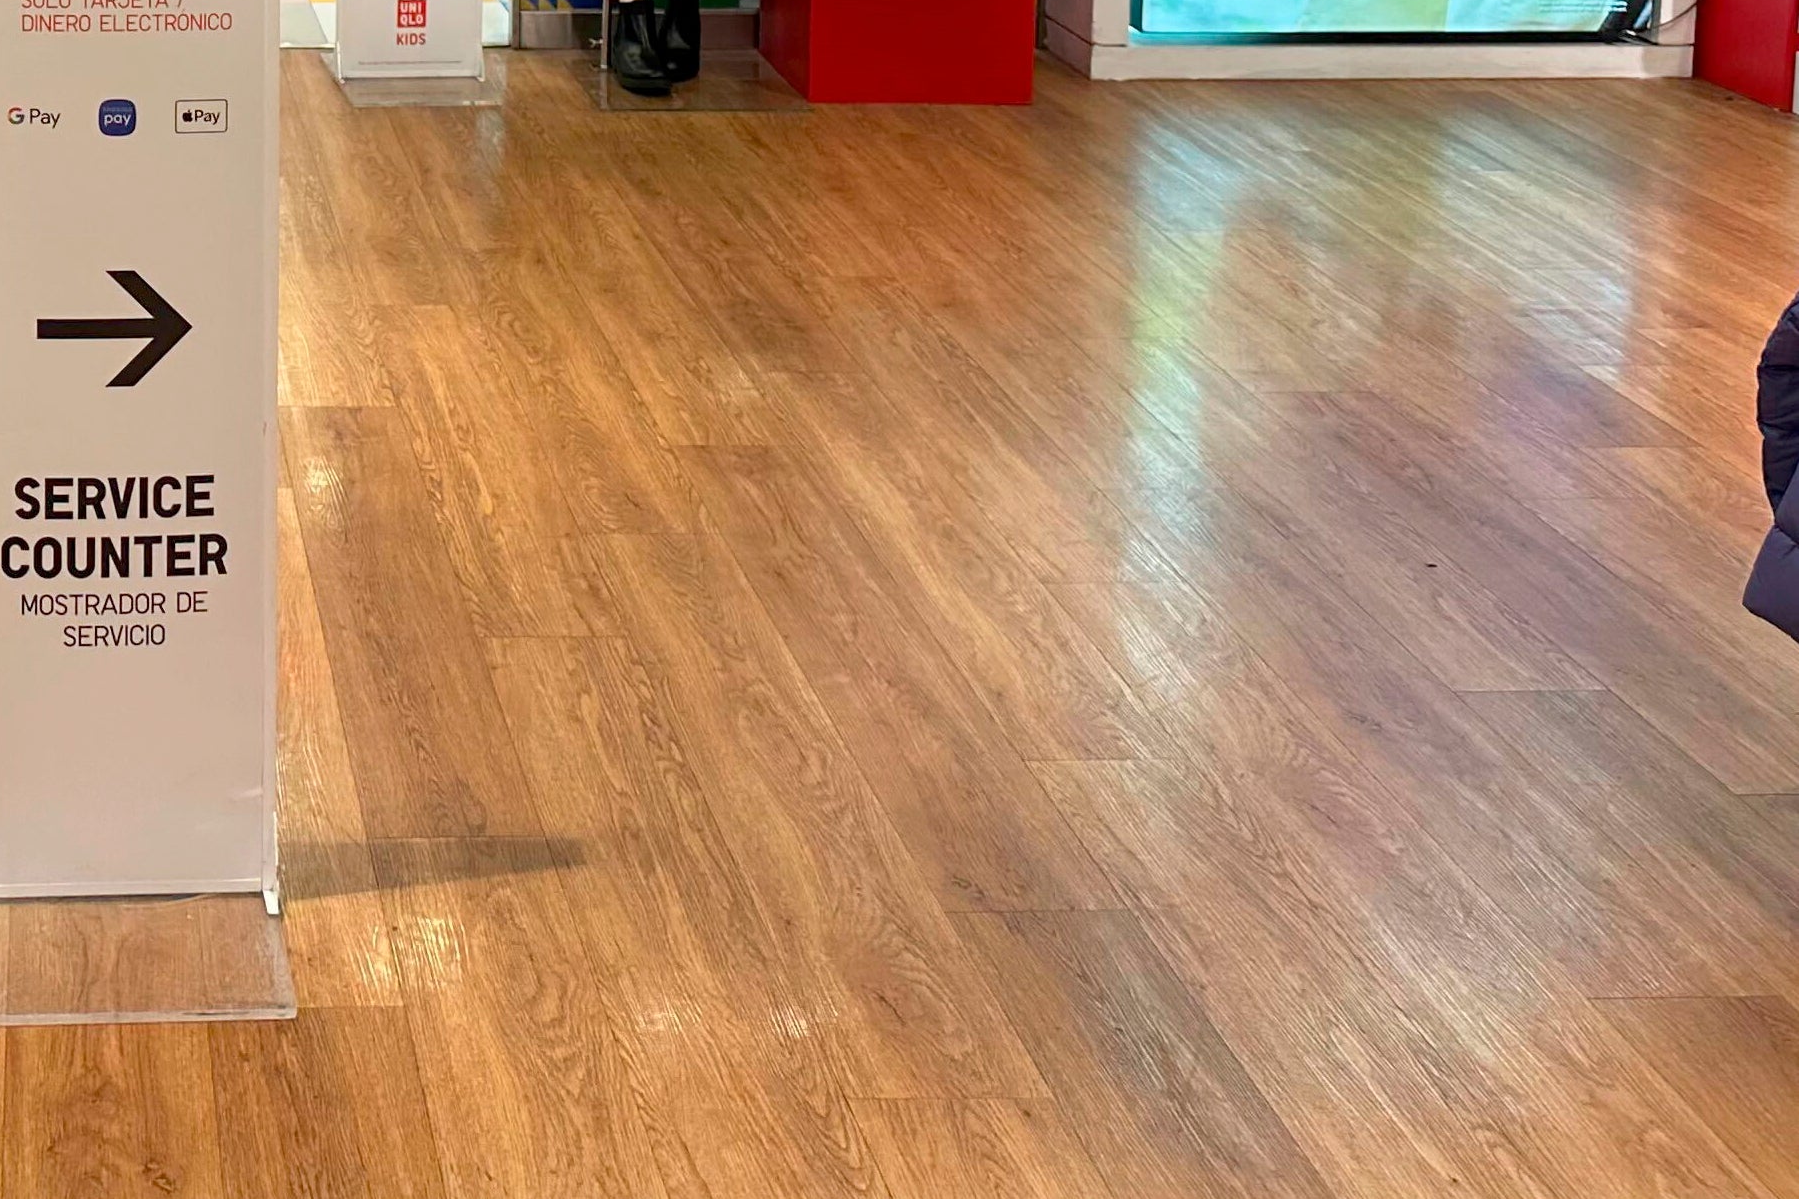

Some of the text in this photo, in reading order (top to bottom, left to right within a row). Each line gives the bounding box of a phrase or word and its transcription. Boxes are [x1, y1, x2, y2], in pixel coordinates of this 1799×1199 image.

[21, 8, 233, 32] DINERO ELECTRÓNICO
[396, 33, 426, 45] KIDS
[29, 108, 61, 128] Pay
[104, 114, 131, 127] pay
[194, 109, 220, 125] Pay
[14, 475, 215, 520] SERVICE
[1, 534, 228, 579] COUNTER
[21, 591, 208, 615] MOSTRADOR DE
[63, 624, 166, 647] SERVICIO
